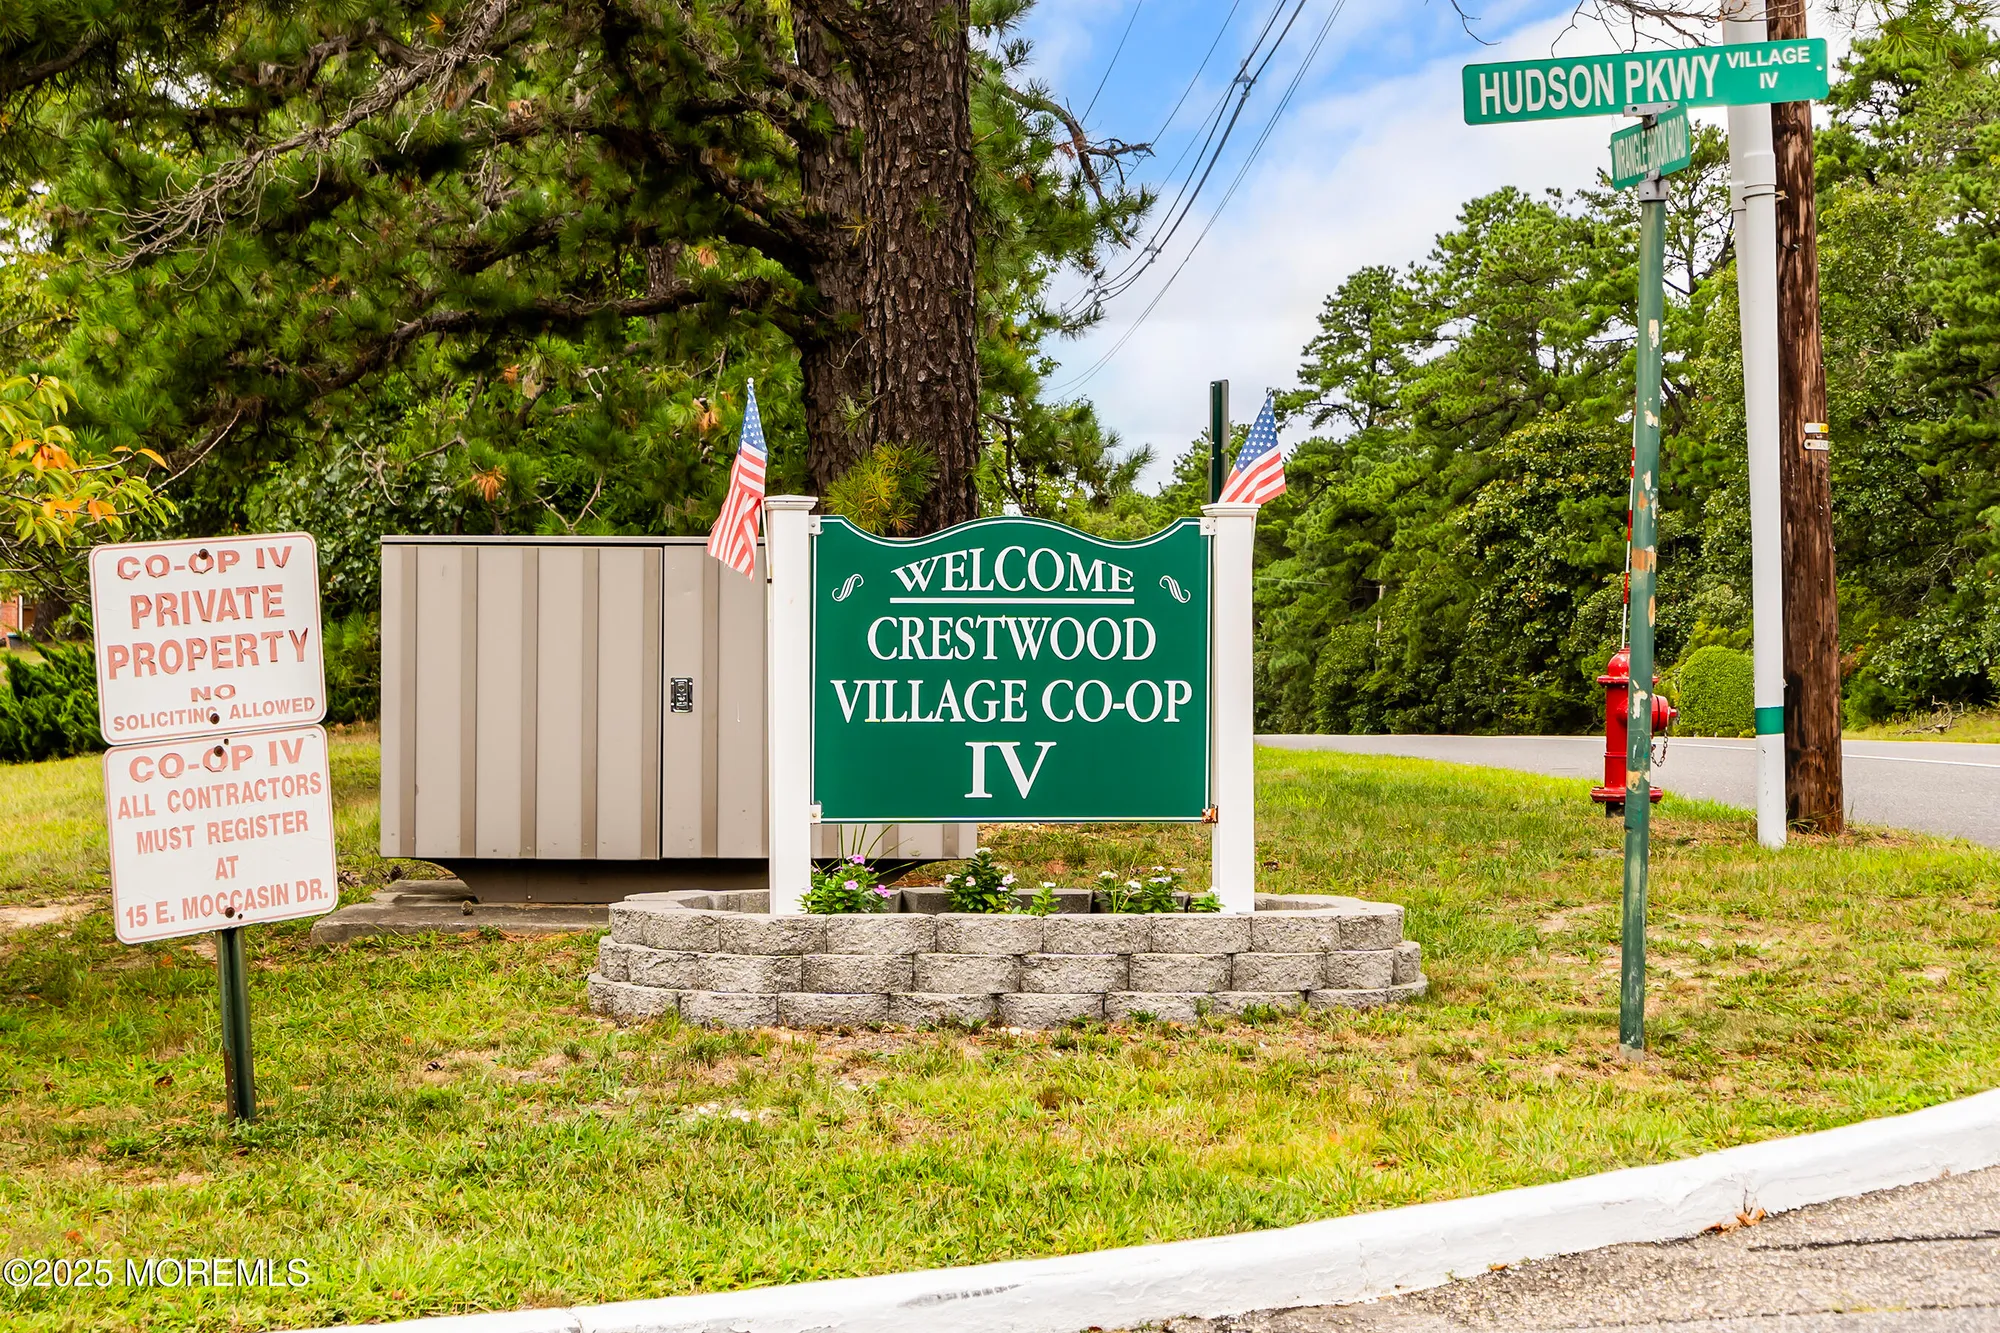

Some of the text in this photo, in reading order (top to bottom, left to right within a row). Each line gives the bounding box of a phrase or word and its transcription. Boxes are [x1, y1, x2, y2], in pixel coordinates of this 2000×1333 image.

[1726, 46, 1811, 69] VILLAGE
[1479, 54, 1720, 116] HUDSON PKWY
[1759, 72, 1778, 89] IV
[1614, 115, 1686, 181] WRANGLE BROOK ROAD
[117, 546, 292, 580] CO-OP IV
[890, 546, 1135, 593] WELCOME
[130, 584, 285, 629] PRIVATE
[107, 627, 308, 680] PROPERTY
[867, 615, 1157, 660] CRESTWOOD
[191, 684, 236, 702] NO
[229, 697, 315, 720] ALLOWED
[830, 679, 1193, 723] VILLAGE CO-OP
[129, 737, 304, 783] CO-OP IV
[964, 741, 1057, 799] IV
[117, 772, 322, 819] ALL CONTRACTORS
[136, 810, 309, 855] MUST REGISTER
[215, 855, 239, 880] AT
[126, 878, 328, 928] 15 E. MOCCASIN DR.
